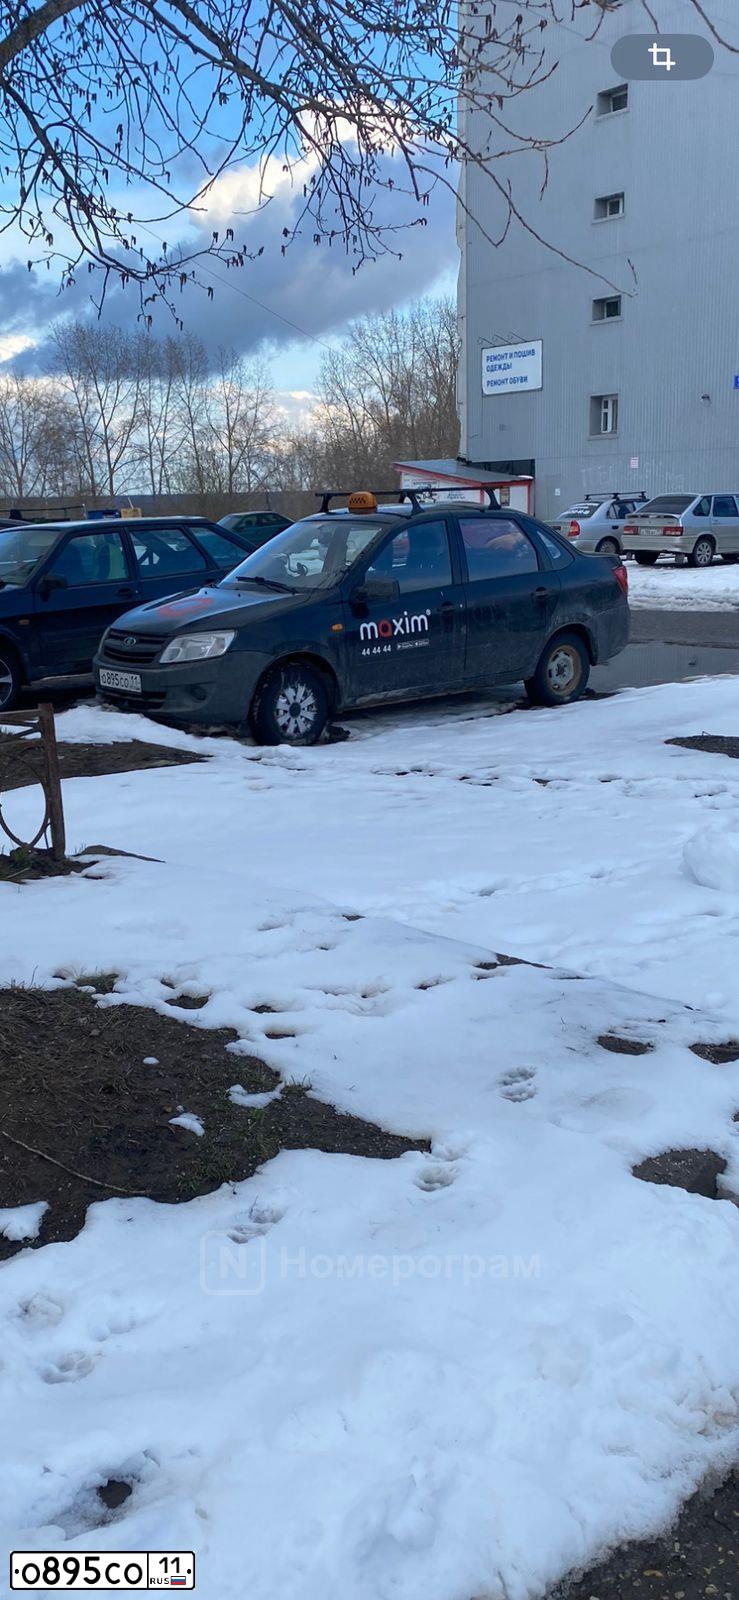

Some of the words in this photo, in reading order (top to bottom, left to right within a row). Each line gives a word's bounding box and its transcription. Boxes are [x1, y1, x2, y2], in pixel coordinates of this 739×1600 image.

[486, 352, 508, 363] РЕМОНТ
[509, 352, 513, 360] И
[514, 348, 536, 359] ПОШИВ
[486, 362, 513, 373] ОДЕЖДЫ
[486, 377, 508, 388] РЕМОНТ
[509, 375, 528, 385] ОБУВИ
[360, 611, 428, 640] maxim
[361, 647, 370, 656] 44
[372, 646, 381, 654] 44
[382, 644, 391, 653] 44
